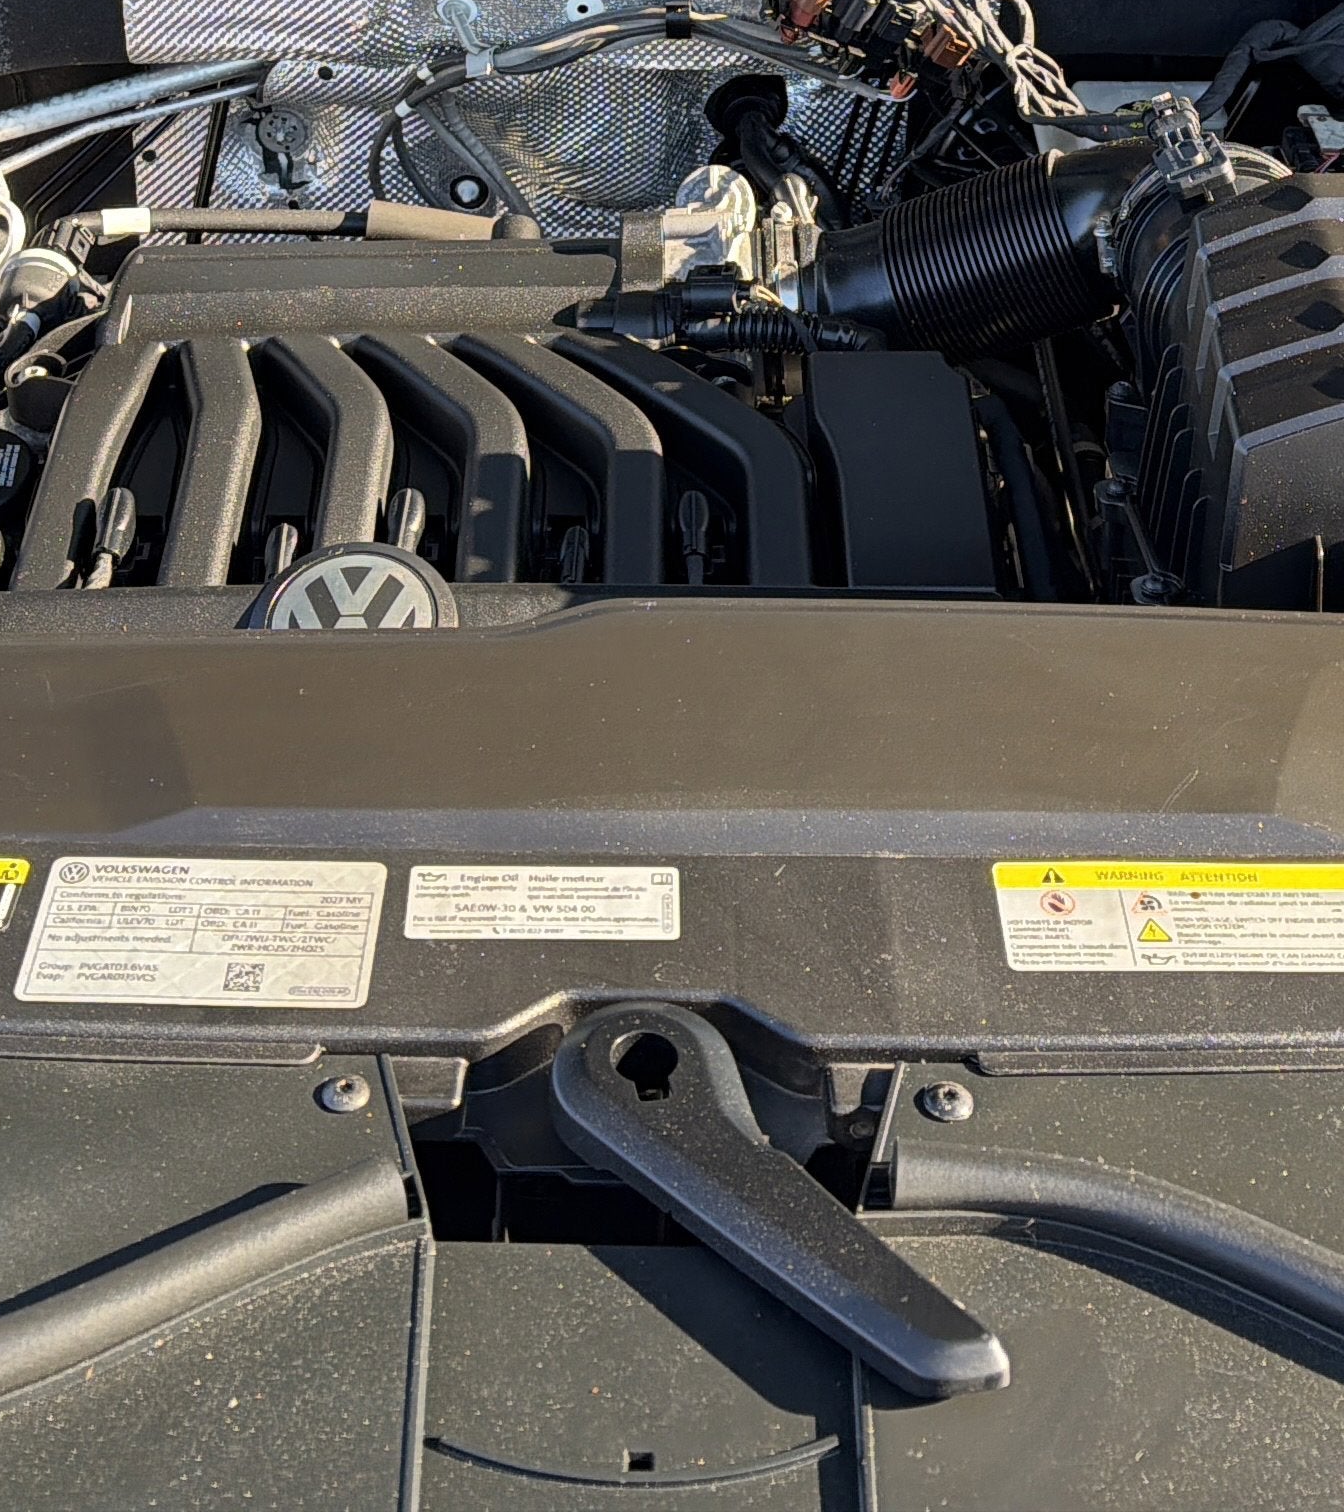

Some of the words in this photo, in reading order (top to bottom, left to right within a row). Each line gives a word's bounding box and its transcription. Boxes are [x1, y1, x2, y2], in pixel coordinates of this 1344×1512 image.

[94, 864, 191, 877] VOLKSWAGEN
[92, 875, 132, 883] VEHICLE
[137, 876, 188, 885] EMISSION
[188, 877, 236, 886] CONTROL
[239, 878, 313, 887] INFORMATION
[460, 874, 499, 884] Engine
[502, 873, 519, 882] Oil
[528, 874, 560, 883] Huile
[562, 874, 606, 883] moteur
[1096, 871, 1164, 881] WARNING
[1180, 872, 1258, 882] ATTENTION
[316, 910, 361, 918] Gasoline
[532, 904, 554, 913] VW
[556, 904, 578, 913] 504
[581, 904, 596, 913] 00
[314, 922, 360, 931] Gasoline
[64, 933, 130, 944] adjustments
